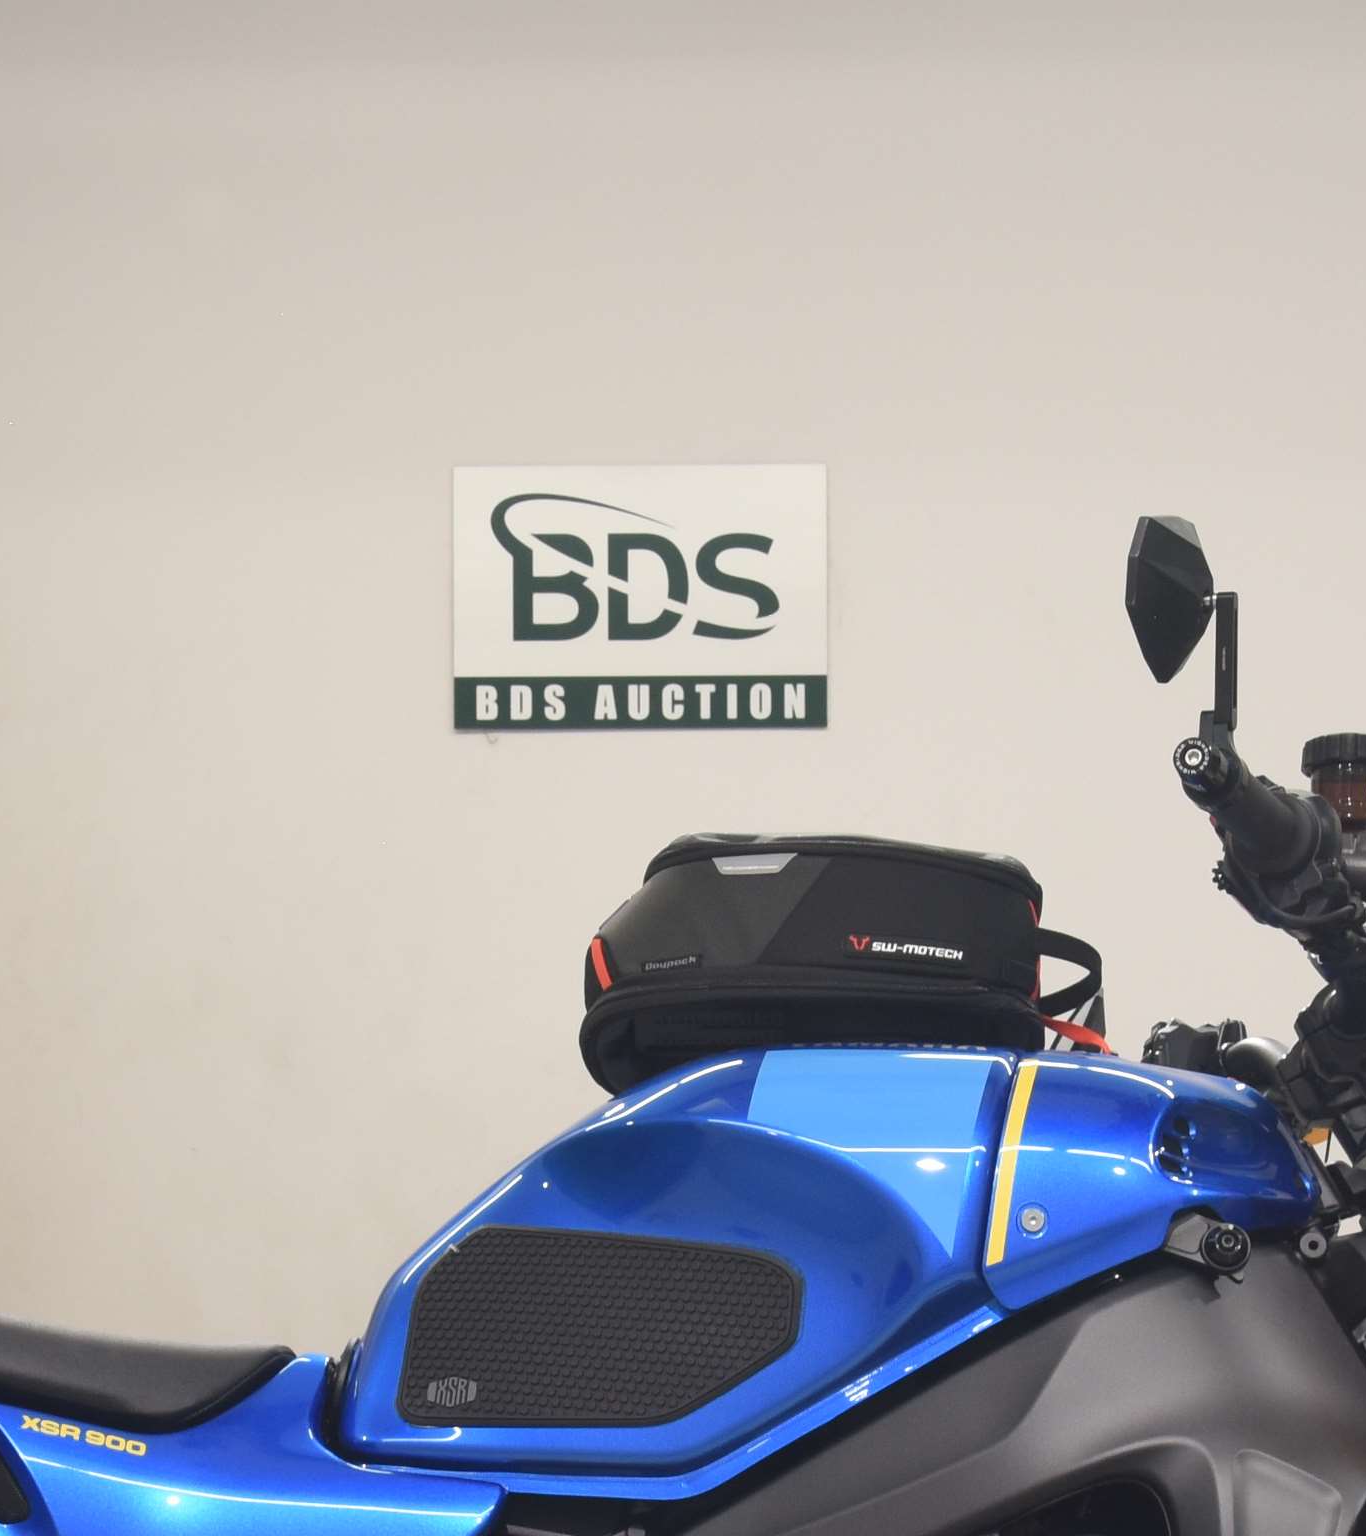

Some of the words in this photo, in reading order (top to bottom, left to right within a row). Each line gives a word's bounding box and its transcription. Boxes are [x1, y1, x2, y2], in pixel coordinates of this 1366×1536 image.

[490, 493, 780, 641] BDS
[475, 684, 566, 721] BDS
[594, 683, 806, 720] AUCTION
[871, 941, 964, 960] SW-MOTECH
[435, 1376, 468, 1407] XSR
[21, 1415, 81, 1441] XSR
[85, 1429, 147, 1456] 900
